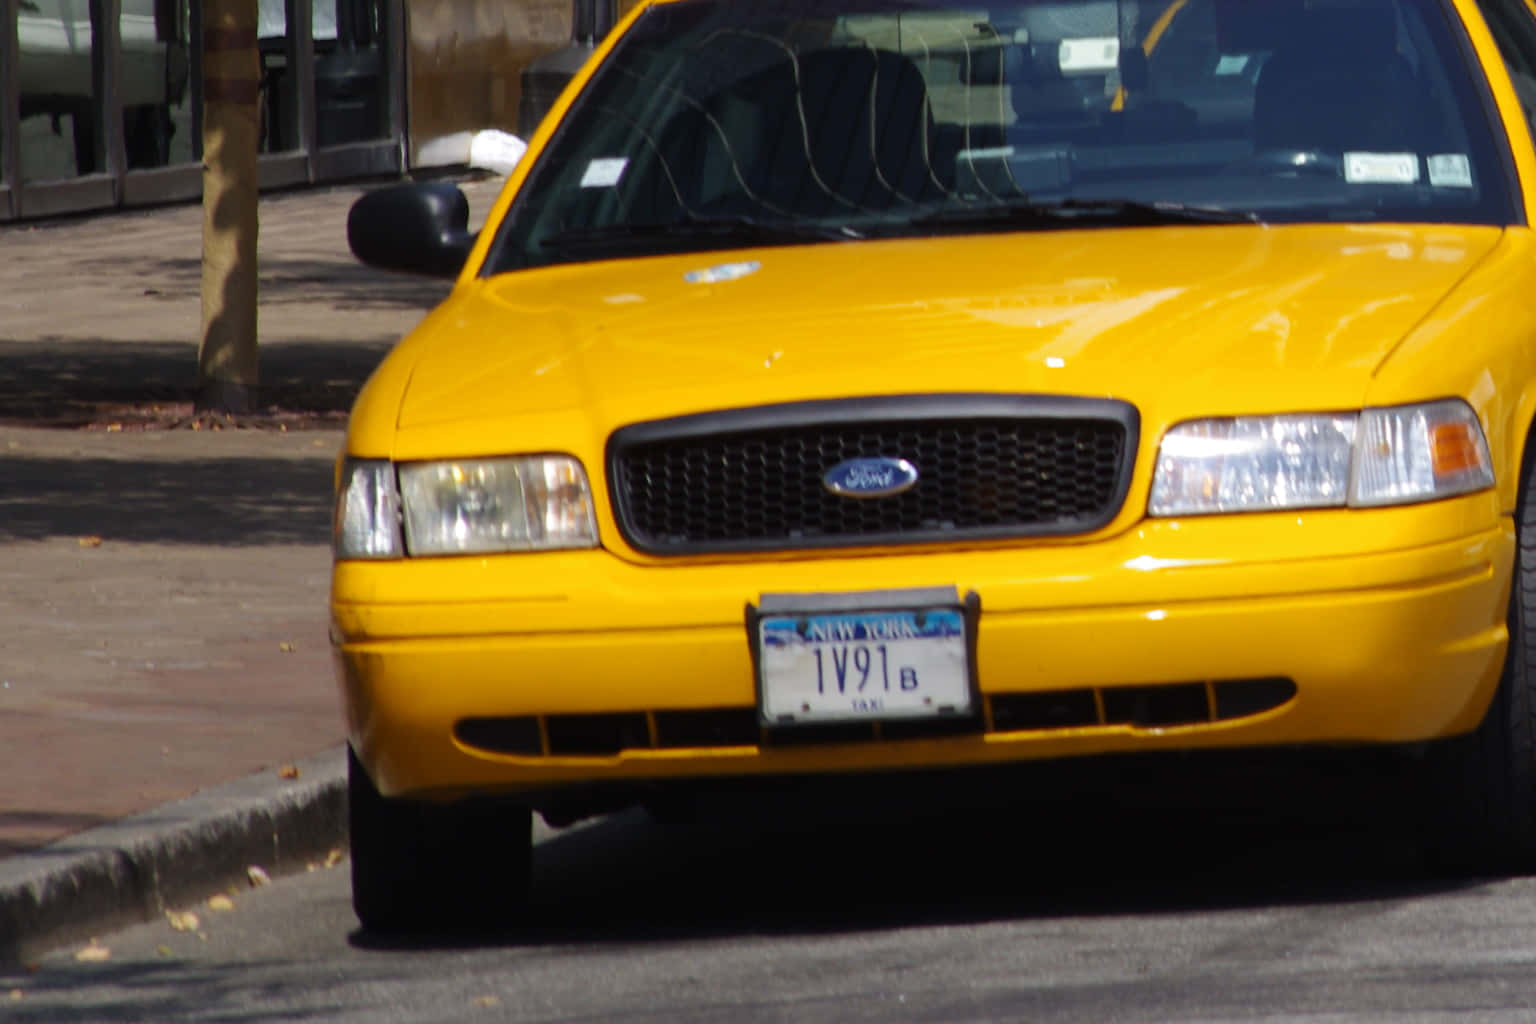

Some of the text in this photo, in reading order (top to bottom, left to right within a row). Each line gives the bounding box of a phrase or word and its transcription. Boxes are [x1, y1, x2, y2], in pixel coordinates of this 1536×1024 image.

[811, 617, 915, 642] NEW YORK
[813, 643, 919, 695] 1V91 B
